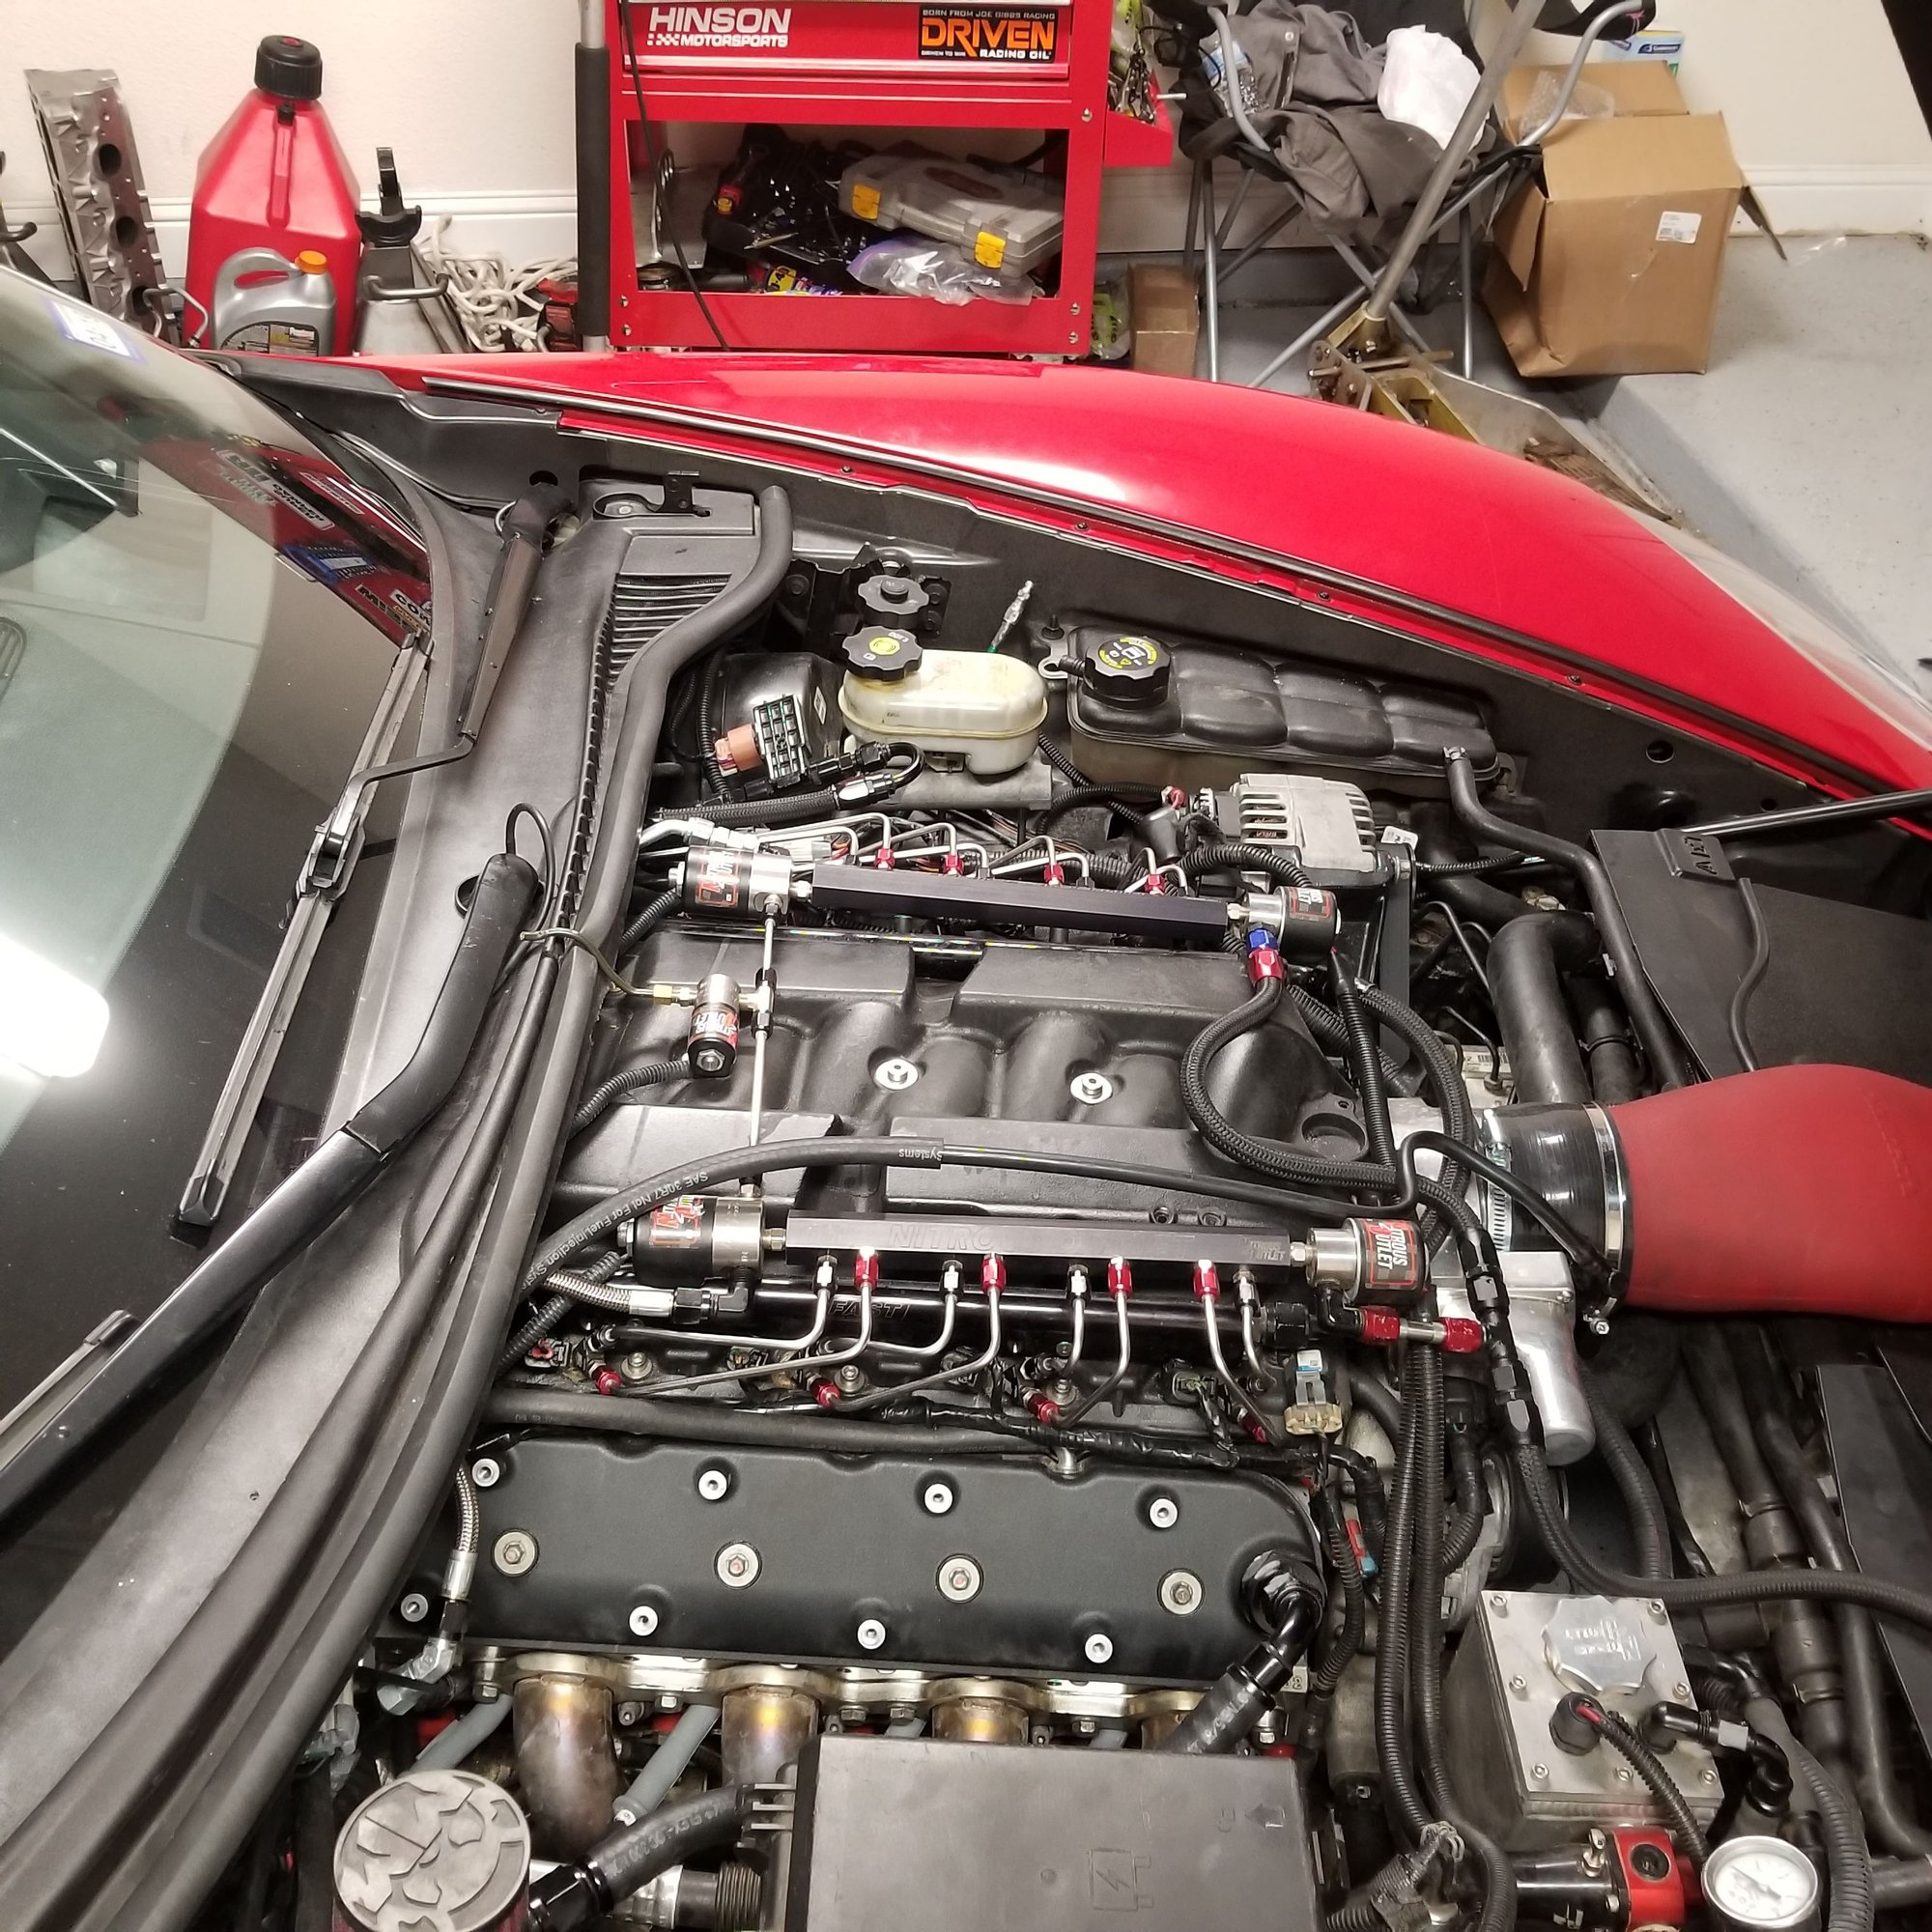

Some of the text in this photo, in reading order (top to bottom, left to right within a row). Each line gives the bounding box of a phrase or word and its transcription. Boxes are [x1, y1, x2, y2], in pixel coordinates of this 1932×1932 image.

[649, 7, 791, 33] HINSON
[680, 34, 788, 47] MOTORSPORTS
[922, 17, 1054, 57] DRIVEN
[980, 49, 1050, 60] RACING OIL
[898, 1146, 943, 1161] Systems
[683, 1172, 709, 1188] SAE
[655, 1183, 683, 1200] 30R7
[634, 1194, 653, 1211] Not
[612, 1205, 633, 1221] For
[586, 1214, 612, 1235] Fuel
[548, 1230, 588, 1266] Injection
